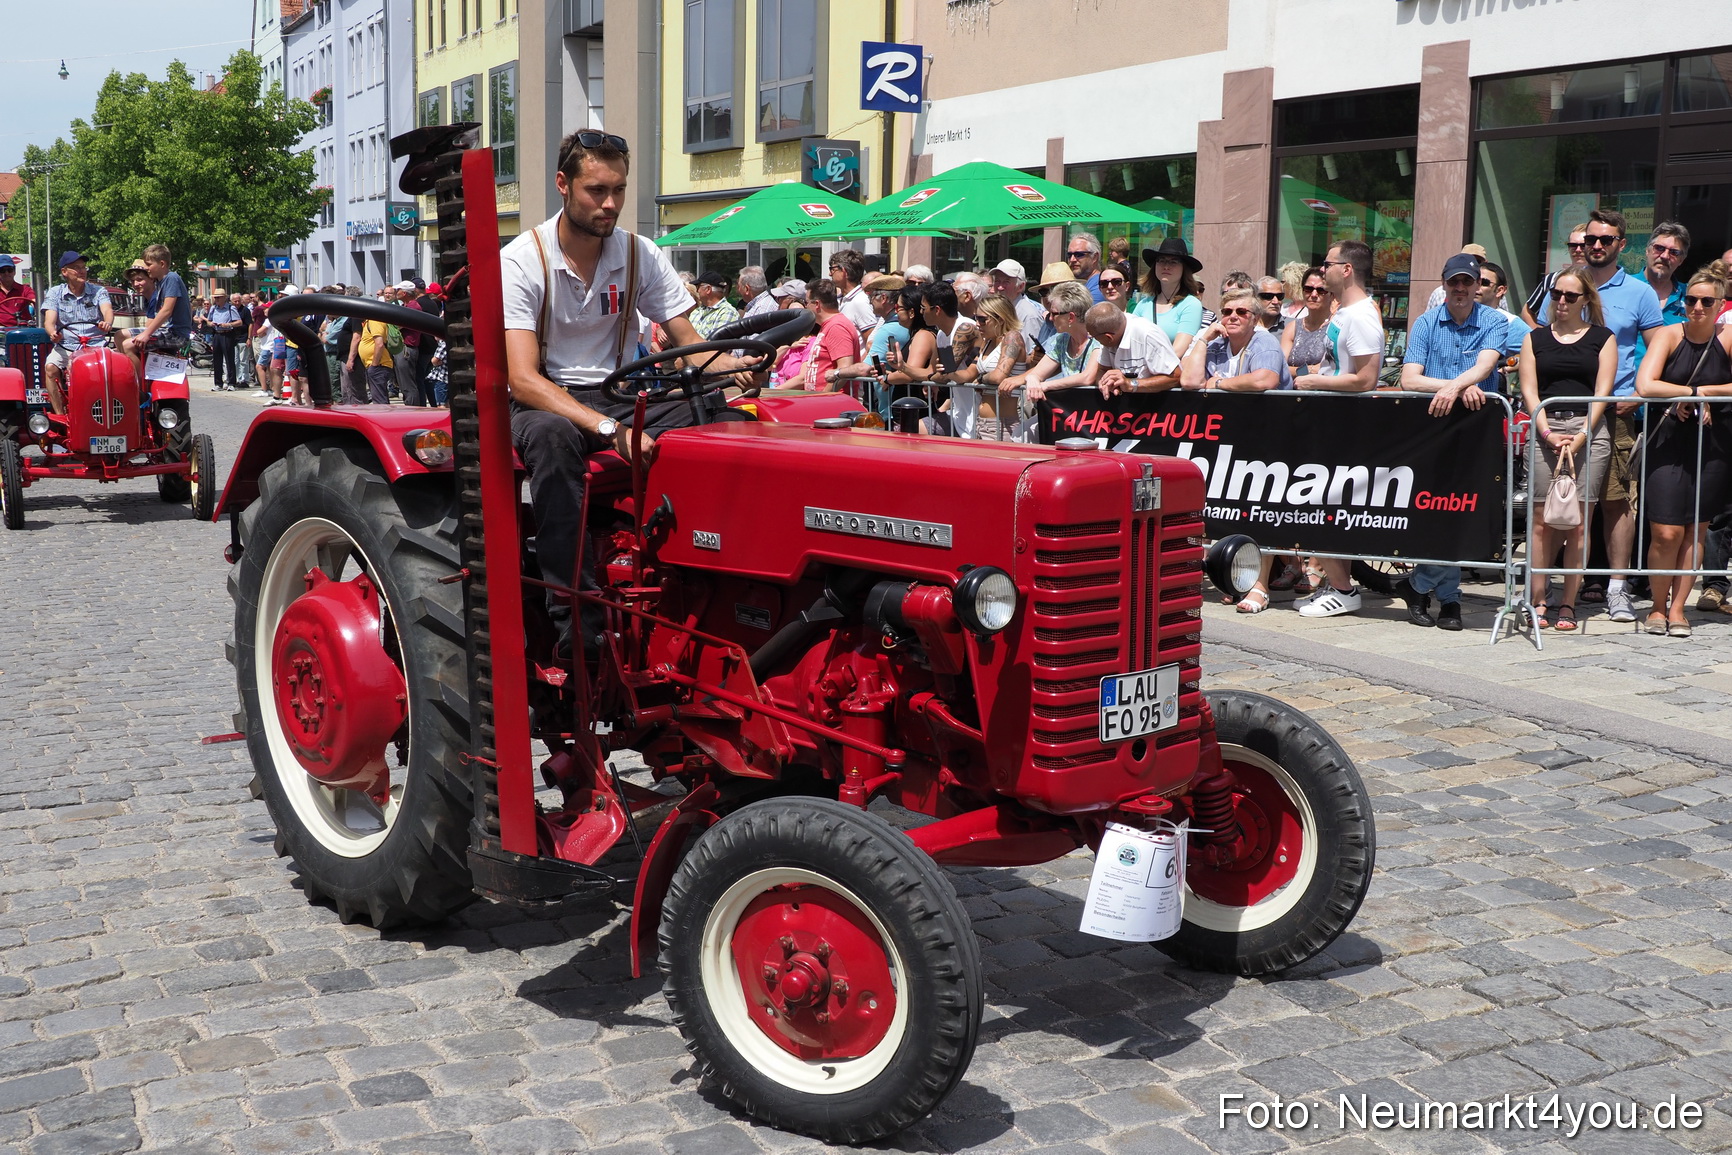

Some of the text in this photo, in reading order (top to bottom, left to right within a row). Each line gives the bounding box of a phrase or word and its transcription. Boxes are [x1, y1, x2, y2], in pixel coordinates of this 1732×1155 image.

[927, 127, 971, 145] Unterer Markt 15
[1007, 208, 1103, 220] Lammsbräu
[1011, 203, 1080, 212] Neumarkter
[1380, 206, 1412, 218] Grillen
[32, 344, 41, 390] HANOMAG
[165, 360, 180, 370] 264
[1051, 407, 1224, 441] FAHRSCHULE
[97, 437, 110, 446] NM
[97, 444, 121, 453] P 108
[1414, 490, 1478, 512] GmbH
[1249, 505, 1325, 527] Freystadt
[1334, 509, 1409, 531] Pyrbaum
[1118, 673, 1158, 706] LAU
[1105, 702, 1161, 739] FO 95
[1165, 856, 1177, 879] 6
